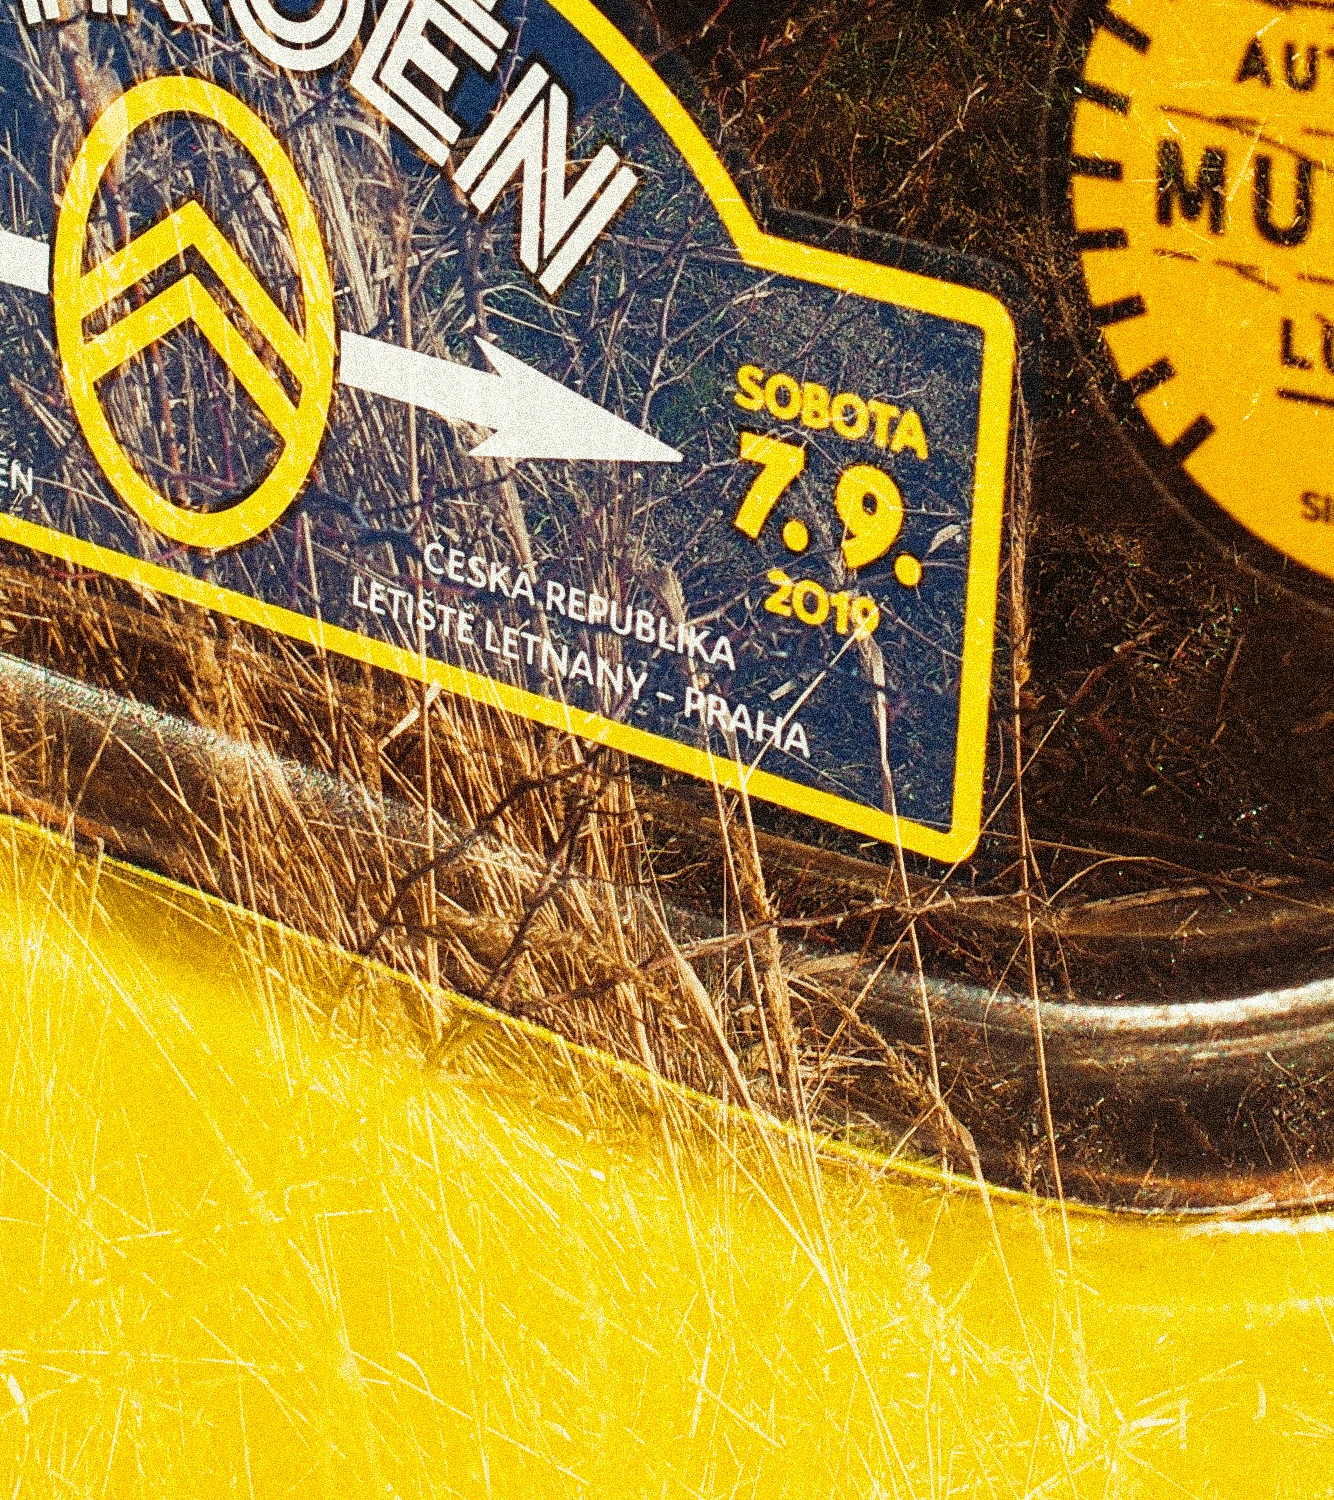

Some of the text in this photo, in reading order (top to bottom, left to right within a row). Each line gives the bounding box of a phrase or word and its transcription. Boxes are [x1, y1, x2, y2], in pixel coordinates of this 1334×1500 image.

[734, 364, 929, 460] SOBOTA
[546, 580, 736, 671] REPUBLIKA
[765, 569, 880, 639] 2019
[352, 576, 475, 645] LETIŠTĚ
[684, 686, 811, 759] PRAHA
